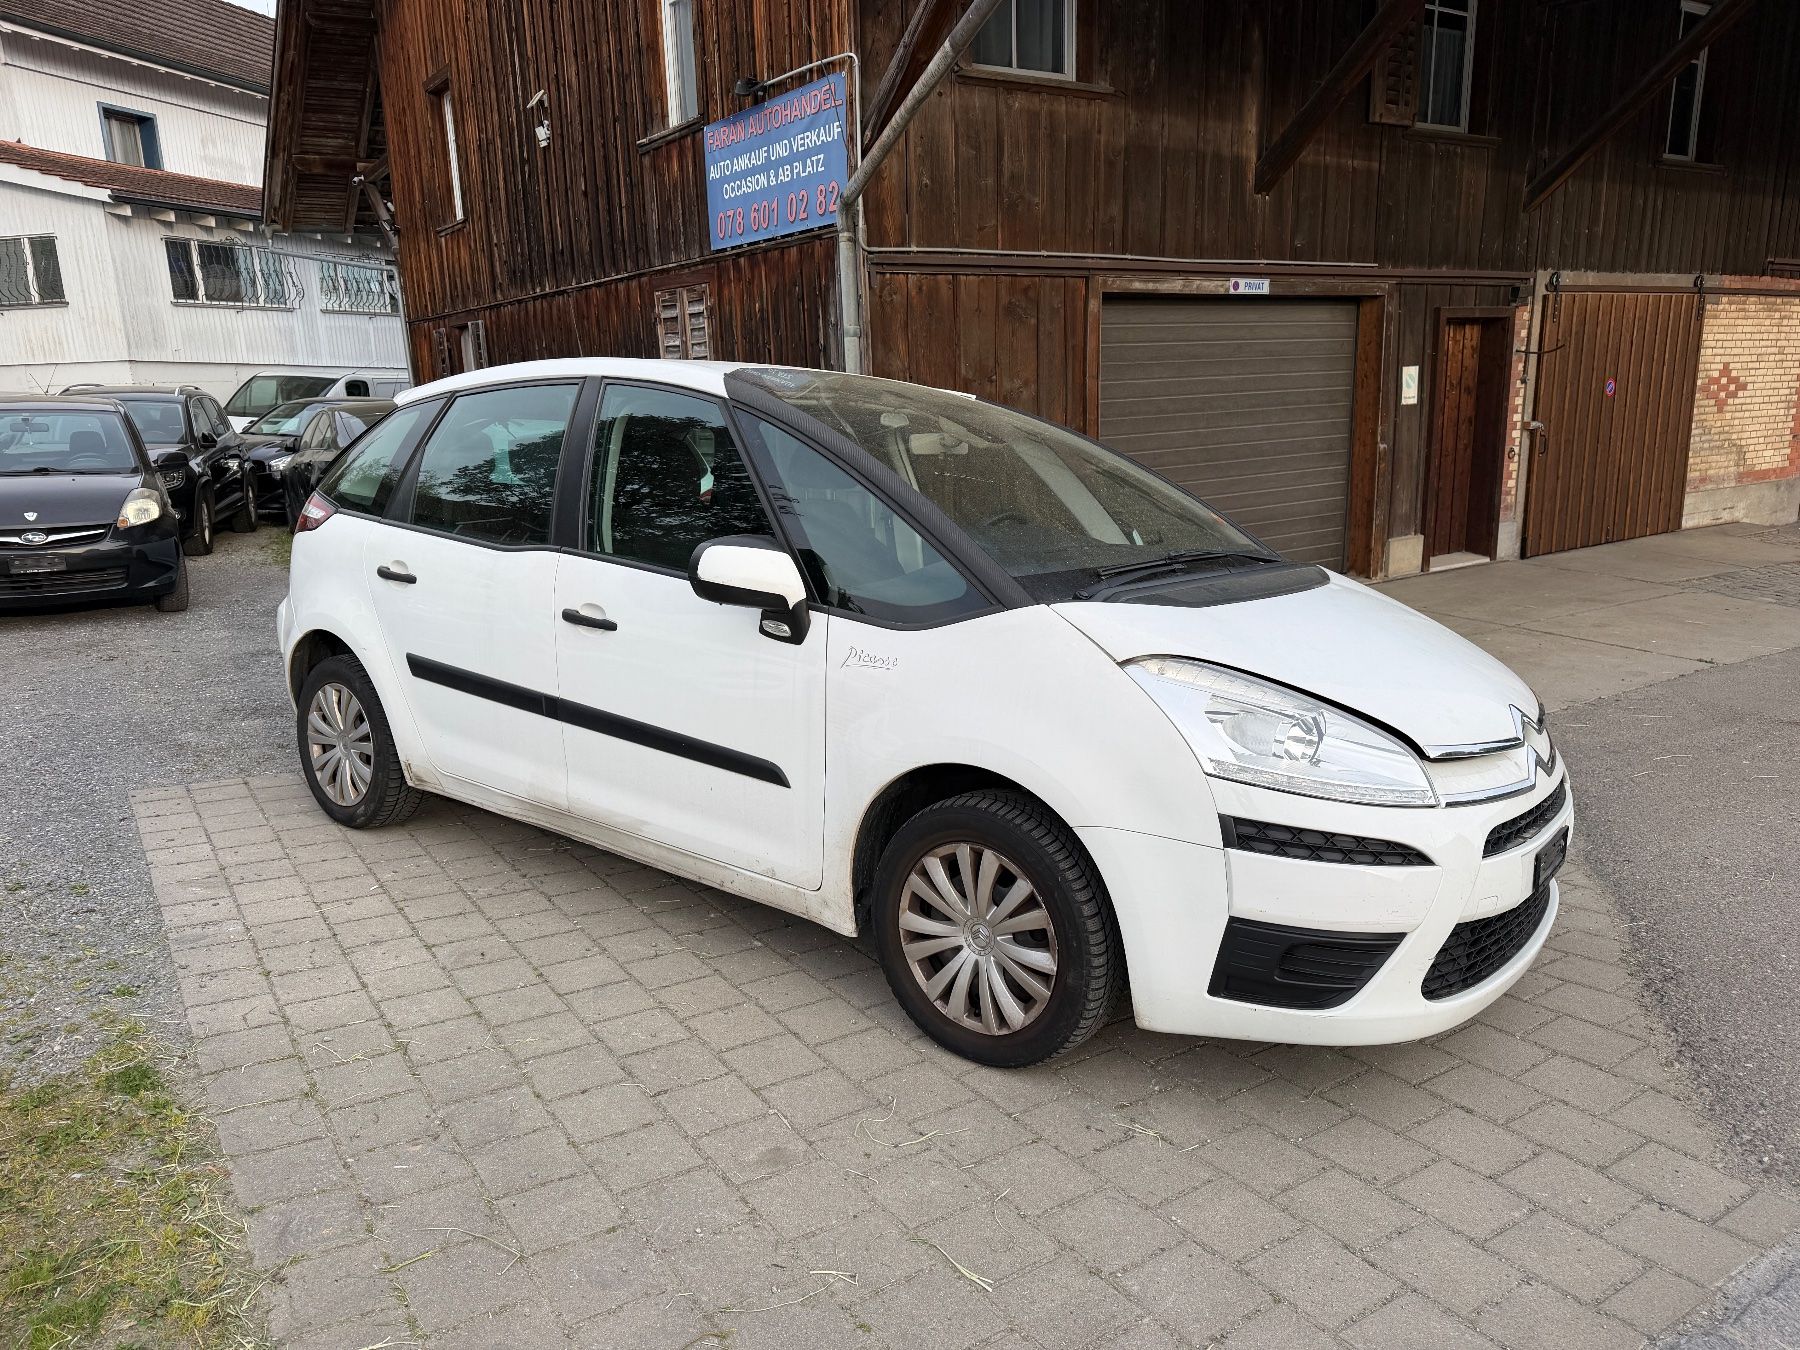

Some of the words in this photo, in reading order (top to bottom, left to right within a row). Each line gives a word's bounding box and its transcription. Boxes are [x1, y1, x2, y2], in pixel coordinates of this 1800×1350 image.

[707, 120, 746, 152] FARAN
[748, 82, 843, 139] AUTOHANDEL
[710, 161, 732, 181] AUTO
[733, 147, 768, 174] ANKAUF
[769, 141, 790, 161] UND
[791, 121, 842, 154] VERKAUF
[723, 174, 768, 199] OCCASION
[769, 169, 777, 186] &
[778, 165, 791, 184] AB
[793, 154, 825, 179] PLATZ
[717, 207, 745, 240] 078
[751, 197, 779, 232] 601
[787, 189, 809, 223] 02
[816, 180, 840, 217] 82
[1244, 281, 1265, 291] PRIVAT
